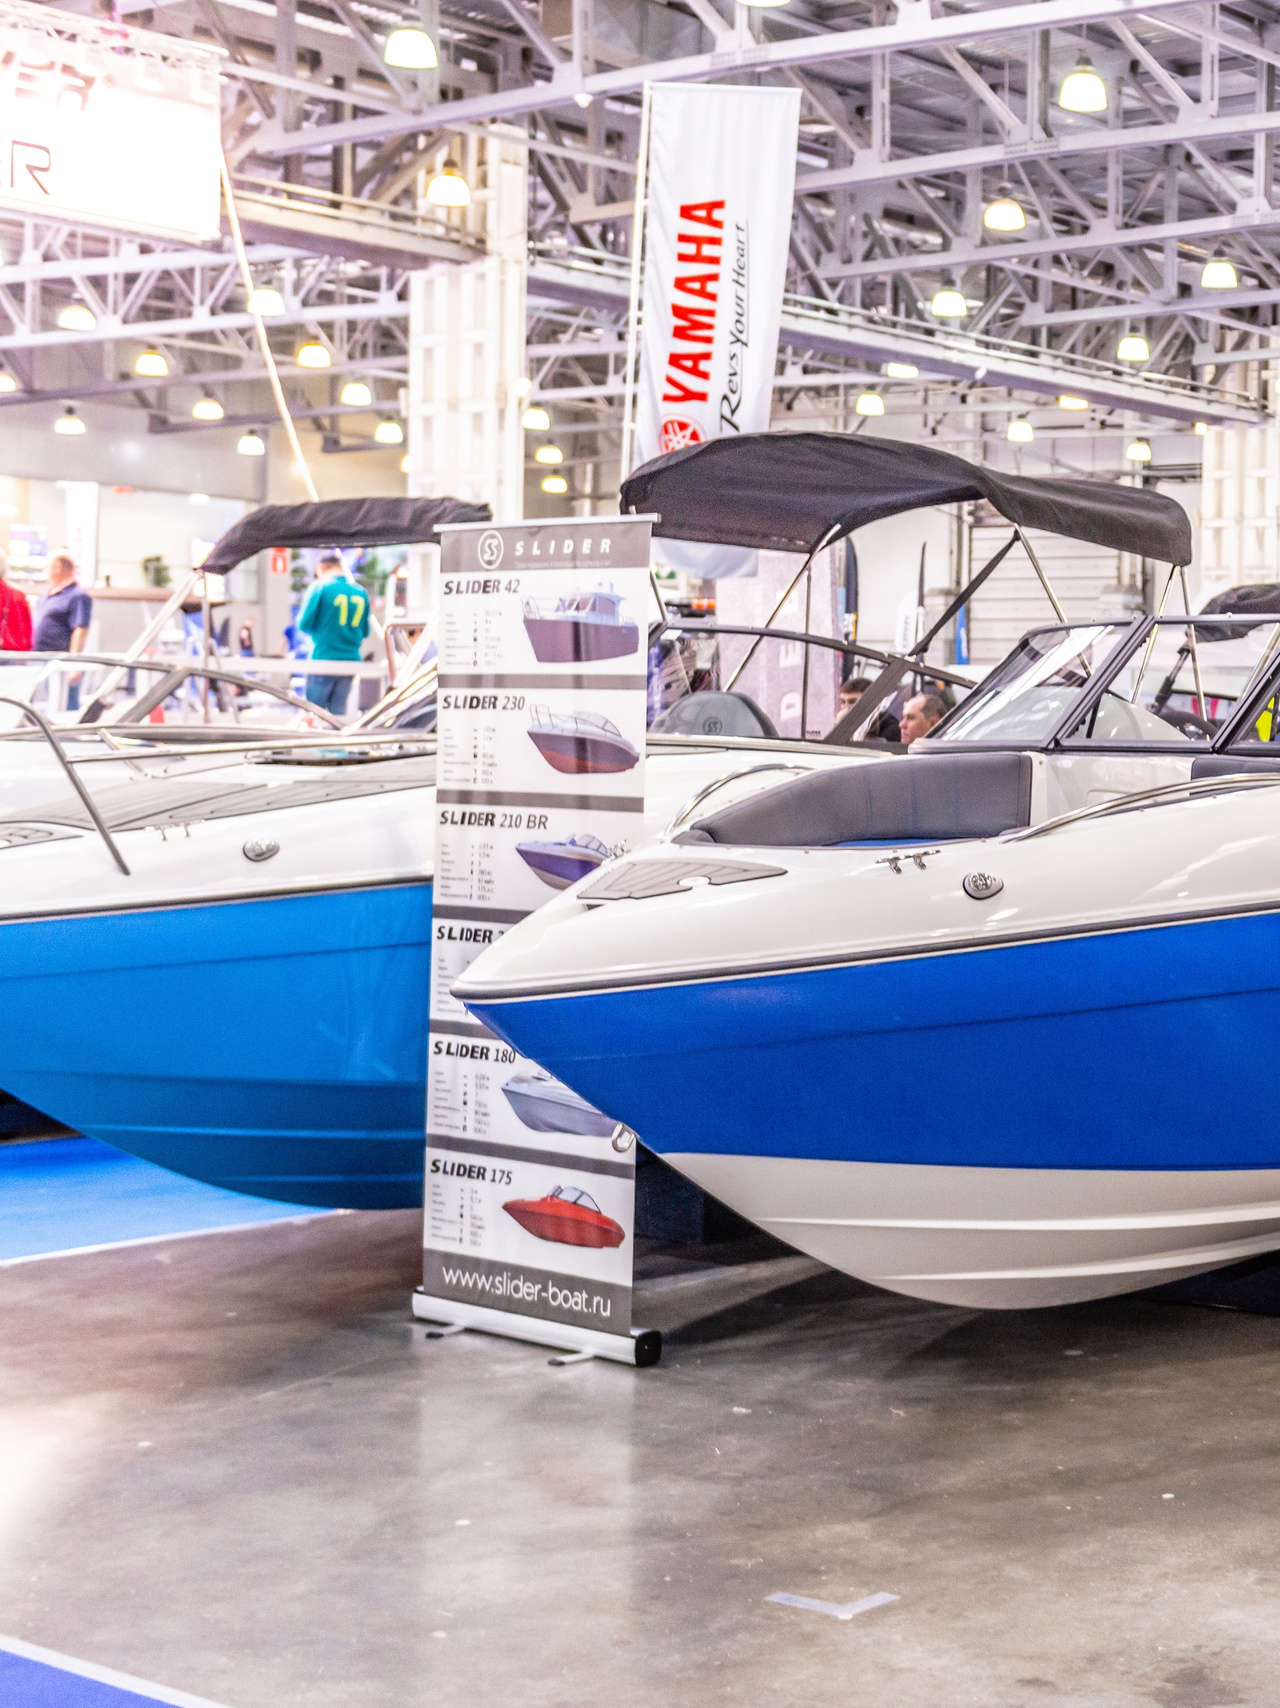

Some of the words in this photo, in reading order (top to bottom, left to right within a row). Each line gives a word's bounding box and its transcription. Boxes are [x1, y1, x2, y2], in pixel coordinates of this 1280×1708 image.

[1, 50, 97, 112] ER
[732, 222, 747, 289] Heart
[662, 200, 726, 403] YAMAHA
[729, 291, 748, 348] Your
[720, 350, 741, 433] Revs
[514, 538, 611, 556] SLIDER
[443, 579, 501, 595] SLIDER
[504, 579, 520, 594] 42
[333, 594, 365, 627] 17
[442, 695, 498, 710] SLIDER
[502, 696, 525, 710] 230
[439, 810, 496, 827] SLIDER
[499, 813, 522, 829] 210
[526, 814, 549, 830] BR
[436, 925, 493, 944] SLIDER
[433, 1040, 490, 1060] SLIDER
[493, 1048, 516, 1064] 180
[430, 1159, 486, 1181] SLIDER
[490, 1168, 513, 1185] 175
[442, 1266, 611, 1318] www.slider-boat.ru
